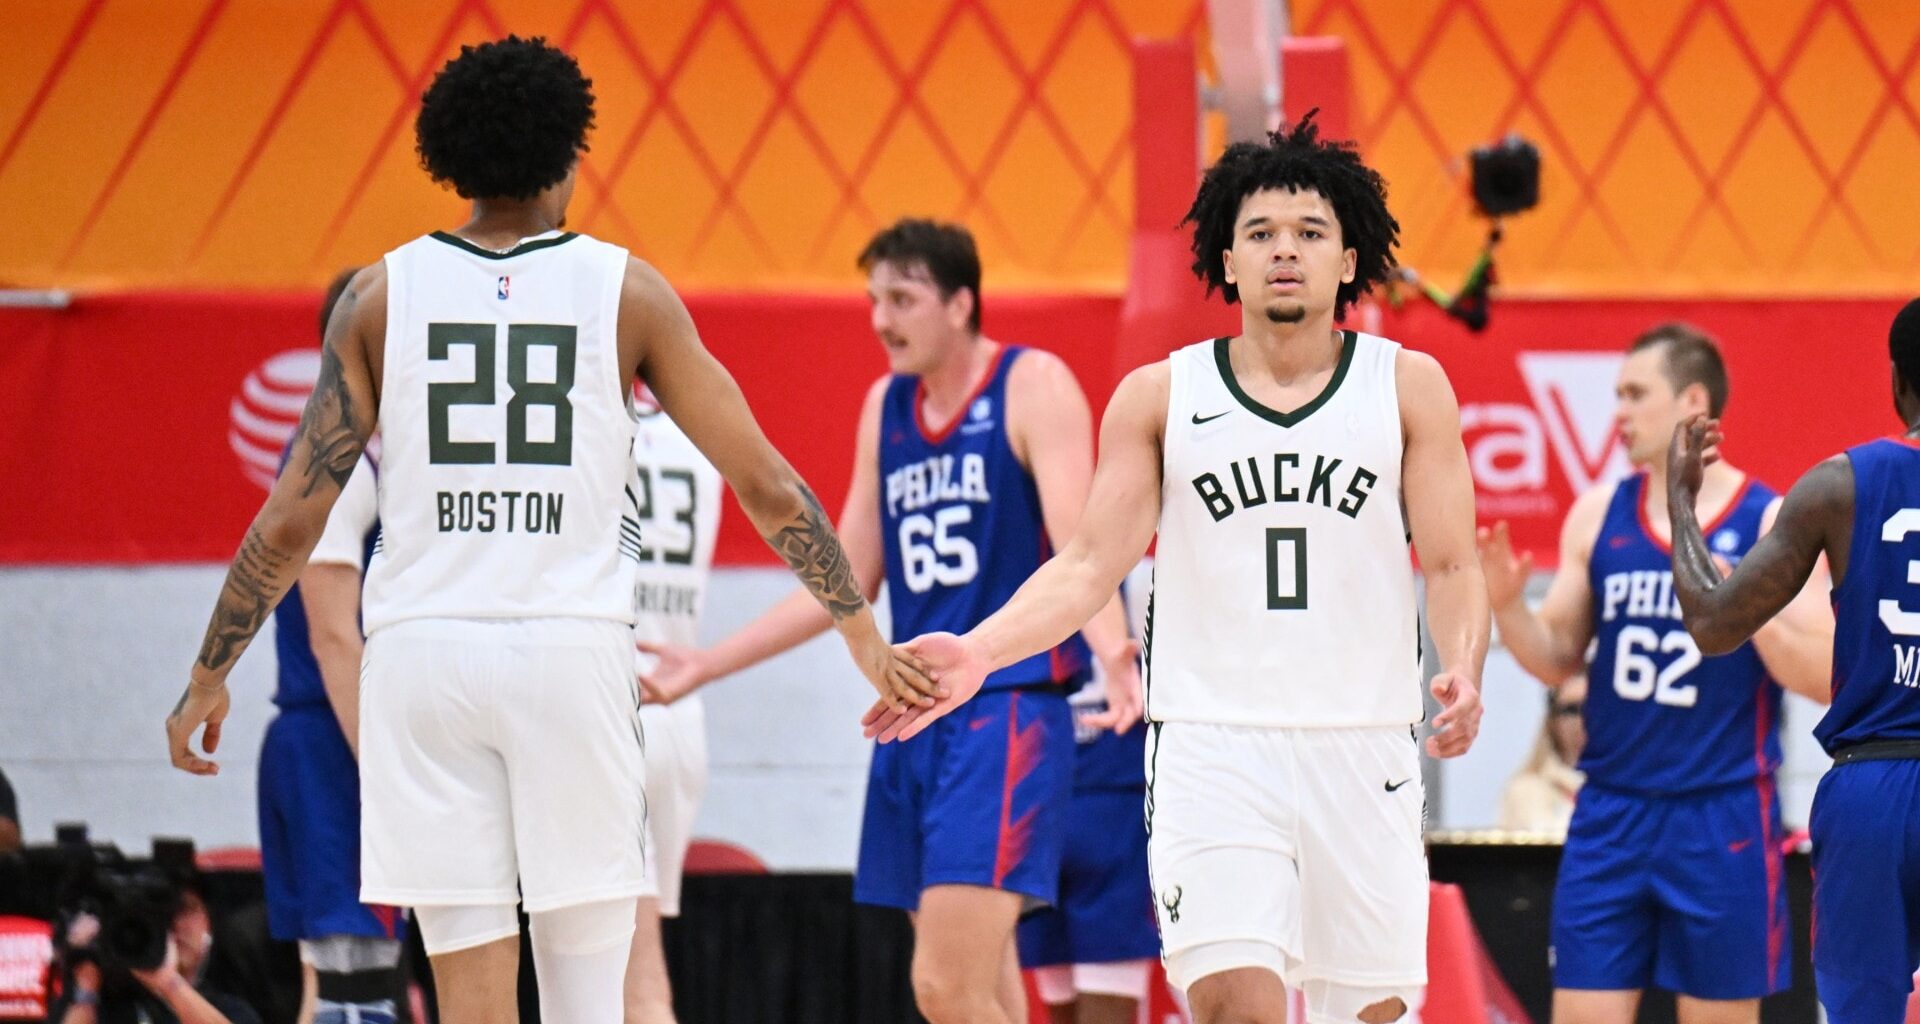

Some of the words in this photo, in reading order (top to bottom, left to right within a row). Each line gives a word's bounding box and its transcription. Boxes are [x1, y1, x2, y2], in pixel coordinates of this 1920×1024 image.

[428, 322, 577, 466] 28
[437, 491, 563, 534] BOSTON
[886, 453, 991, 518] PHILA
[1191, 453, 1378, 523] BUCKS
[899, 504, 979, 593] 65
[1265, 527, 1308, 610] 0
[1613, 624, 1702, 708] 62
